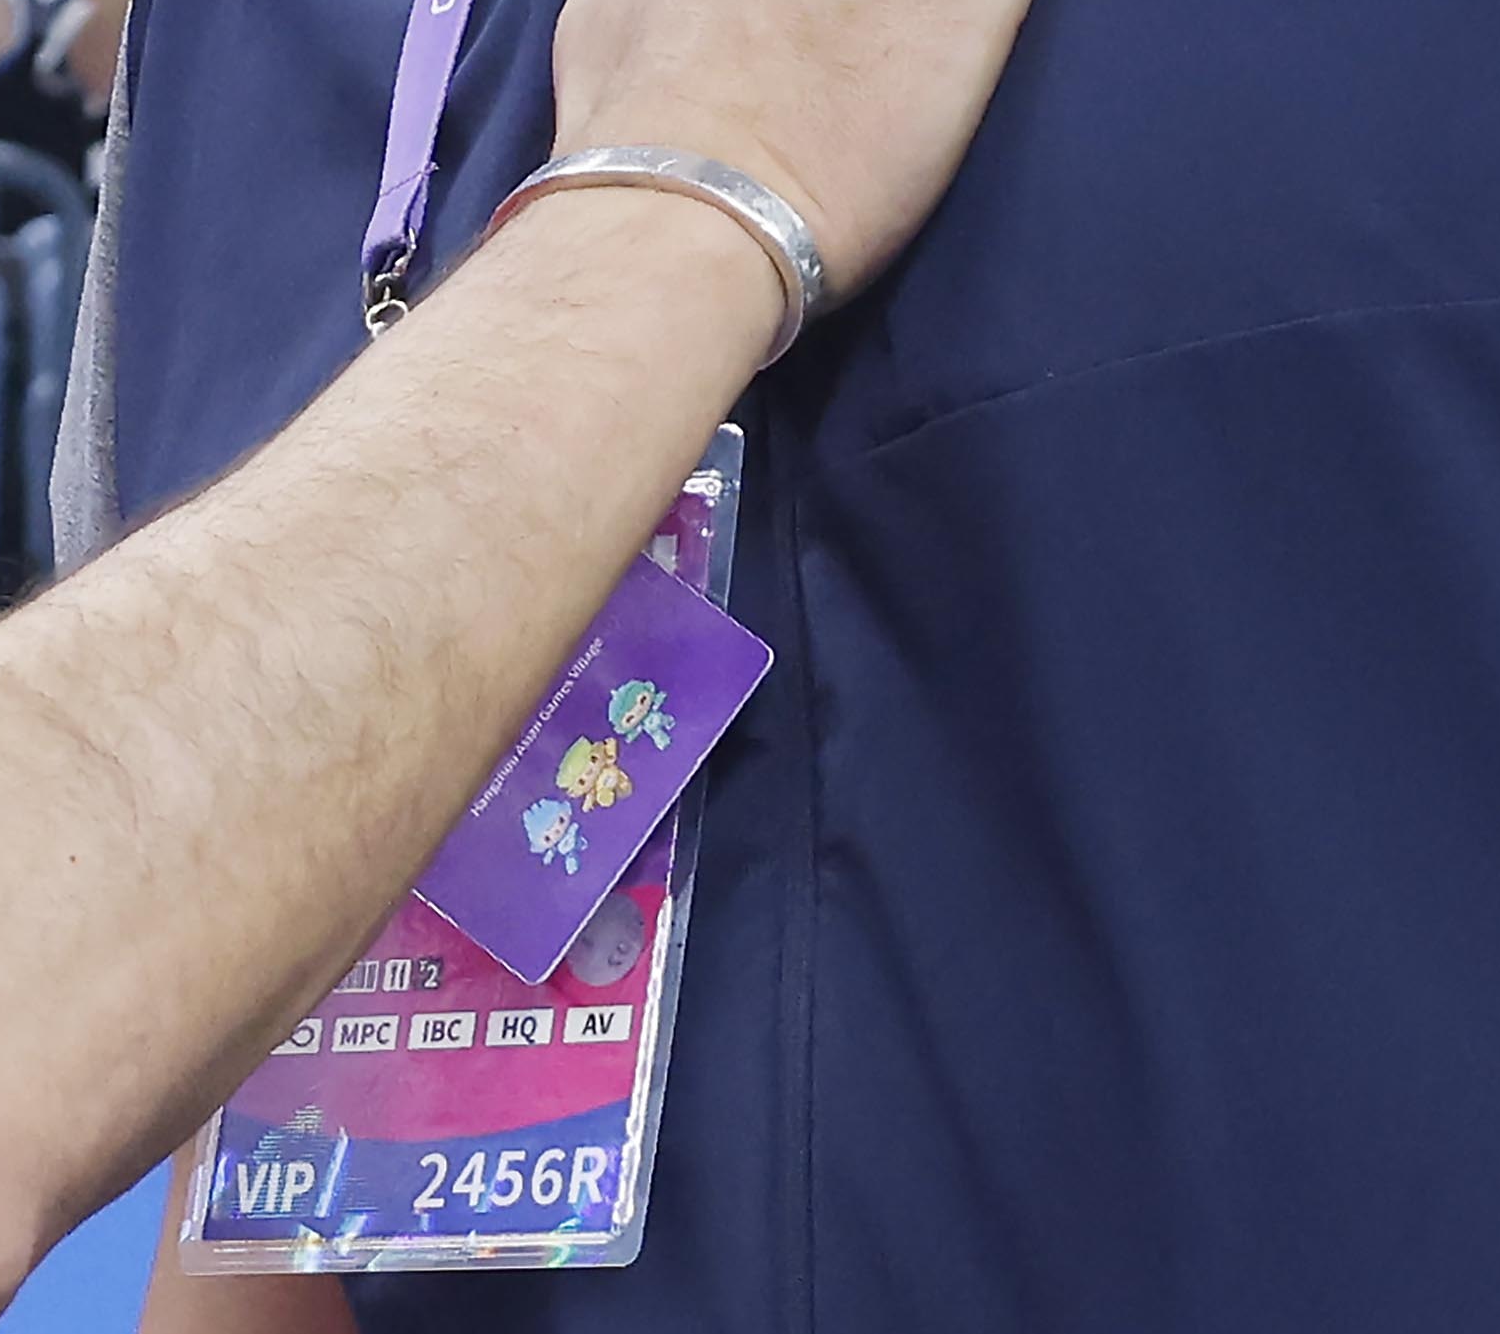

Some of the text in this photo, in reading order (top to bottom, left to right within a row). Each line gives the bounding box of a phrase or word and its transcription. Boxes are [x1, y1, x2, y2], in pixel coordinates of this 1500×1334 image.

[470, 637, 603, 817] Hangzhou Asian Games Village
[339, 1023, 391, 1046] MPC
[421, 1019, 462, 1043] IBC
[501, 1016, 538, 1043] HQ
[582, 1013, 614, 1036] AV
[236, 1146, 608, 1214] VIP 2456R
